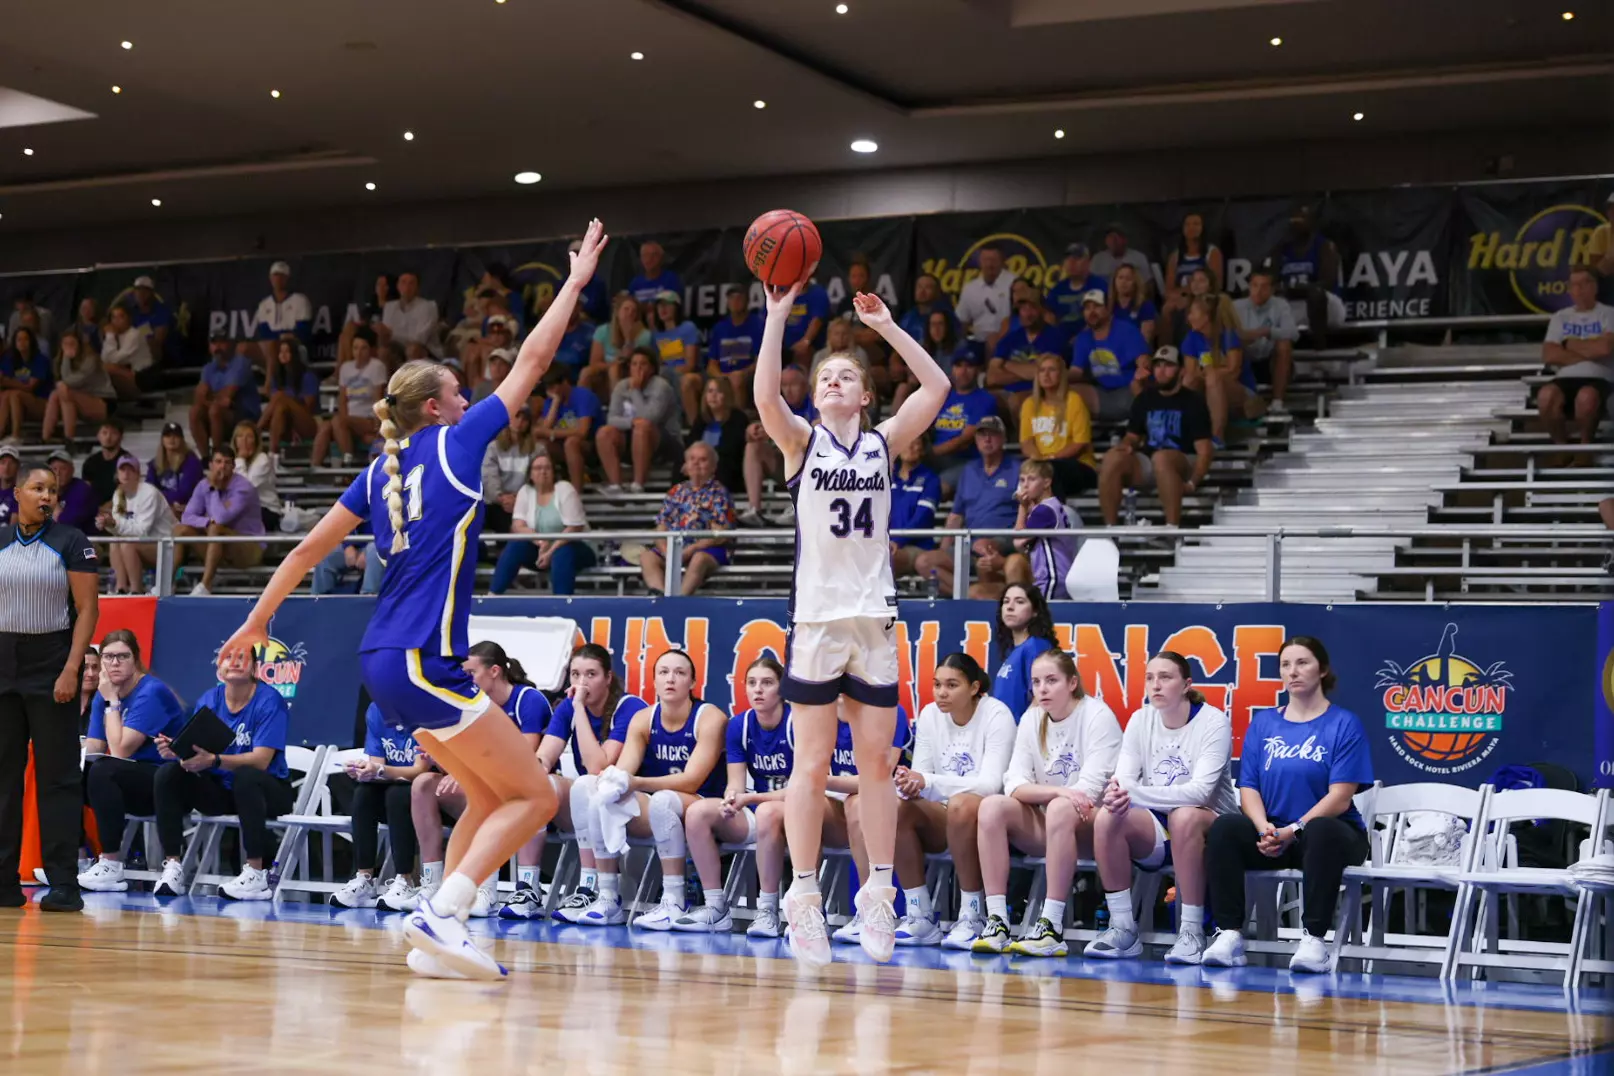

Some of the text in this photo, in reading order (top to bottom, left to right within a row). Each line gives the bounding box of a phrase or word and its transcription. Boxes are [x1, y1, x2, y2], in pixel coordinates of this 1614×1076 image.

[1467, 227, 1566, 270] Hard
[1337, 249, 1439, 289] AYA
[810, 467, 885, 492] Wildcats
[829, 497, 875, 539] 34
[1383, 684, 1506, 715] CANCUN
[1391, 715, 1497, 730] CHALLENGE
[655, 744, 690, 762] JACKS
[752, 752, 788, 771] JACKS
[1263, 735, 1329, 771] Jacks
[1388, 734, 1500, 775] HARD ROCK HOTEL RIVIERA MAYA
